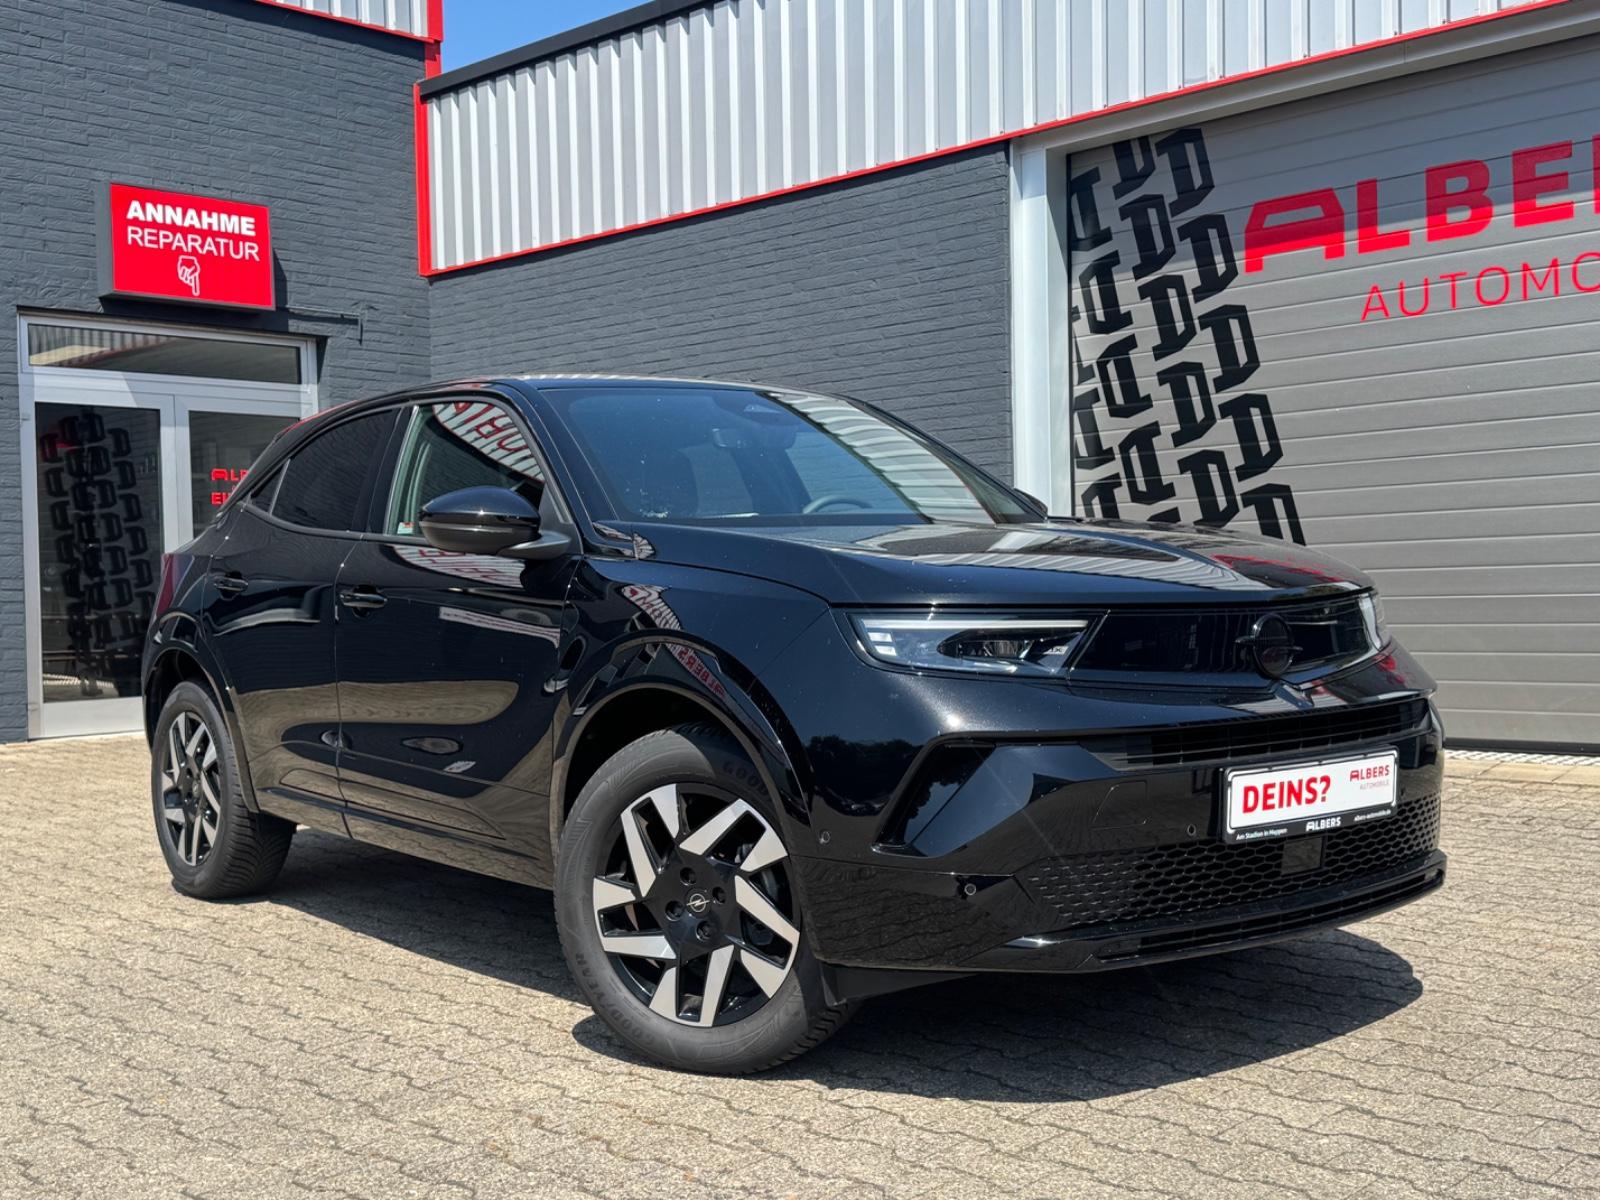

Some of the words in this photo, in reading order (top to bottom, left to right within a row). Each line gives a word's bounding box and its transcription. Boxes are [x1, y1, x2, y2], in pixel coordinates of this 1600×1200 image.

[126, 200, 256, 236] ANNAHME
[1245, 134, 1600, 272] ALBE
[127, 226, 260, 261] REPARATUR
[1361, 252, 1600, 321] AUTOMO
[1350, 765, 1390, 782] ALBERS
[1242, 775, 1331, 813] DEINS?
[1306, 817, 1341, 832] ALBERS
